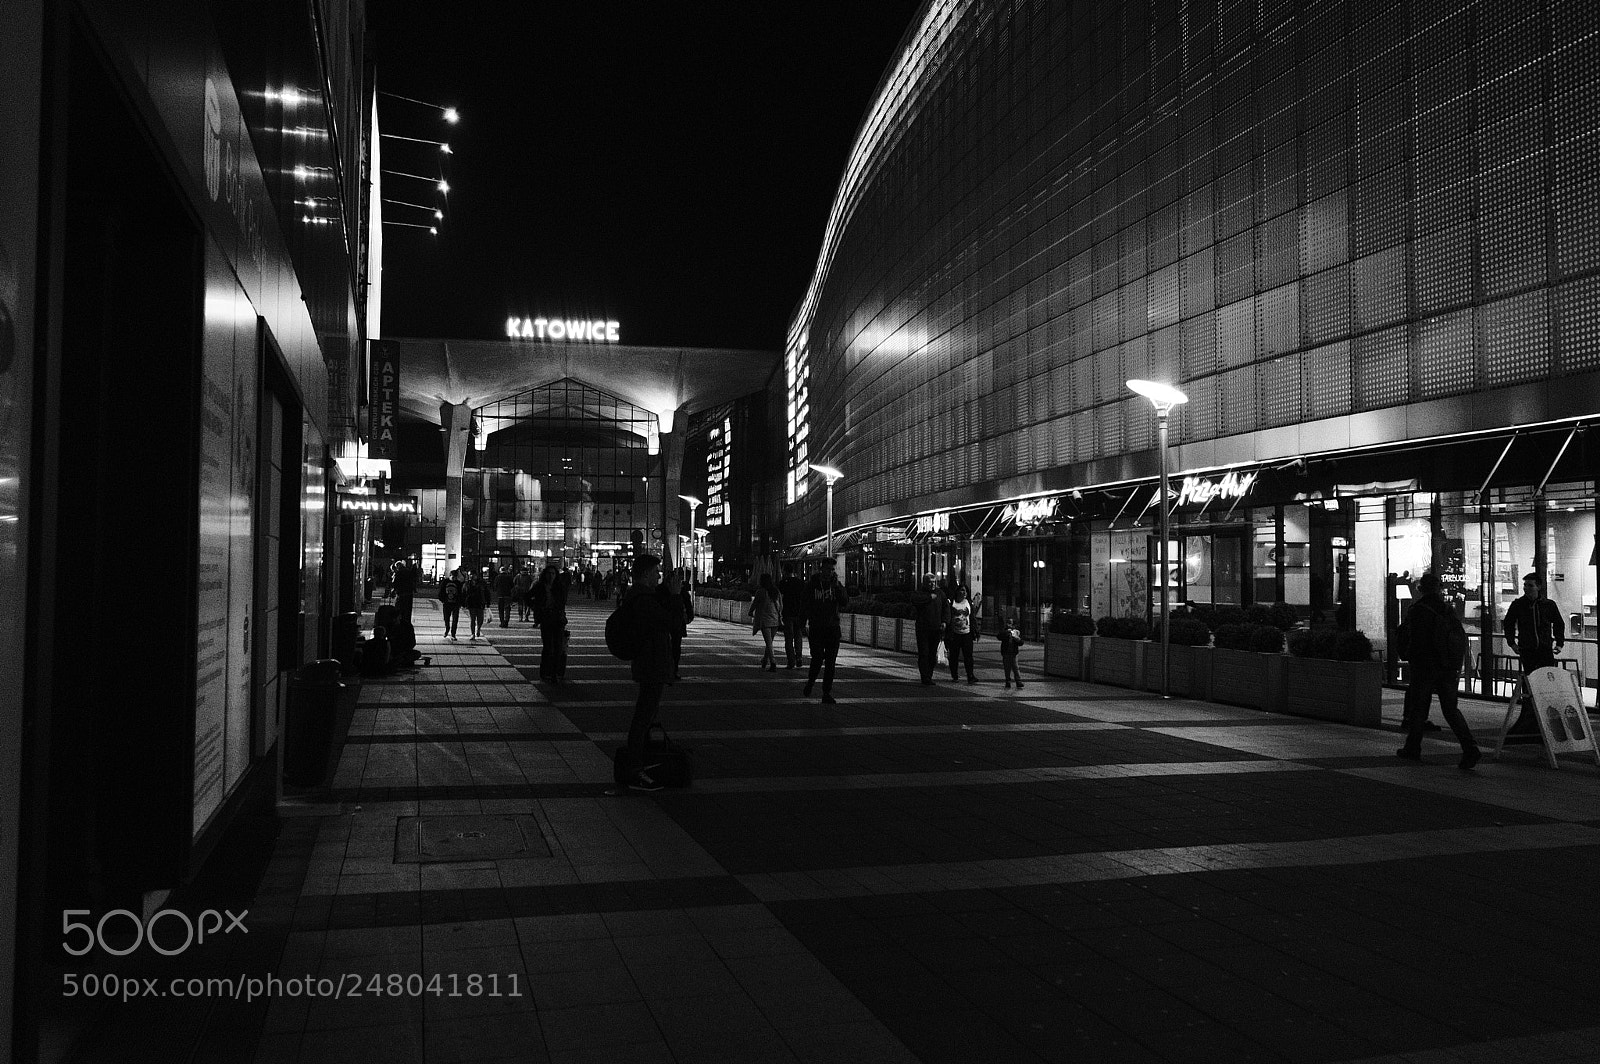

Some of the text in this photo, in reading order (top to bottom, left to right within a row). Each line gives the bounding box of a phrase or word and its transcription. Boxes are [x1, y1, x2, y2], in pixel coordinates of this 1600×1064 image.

[507, 318, 619, 340] KATOWICE
[380, 361, 395, 441] APTEKA
[1179, 472, 1254, 507] Pizza Hut
[342, 500, 415, 512] KANTOR
